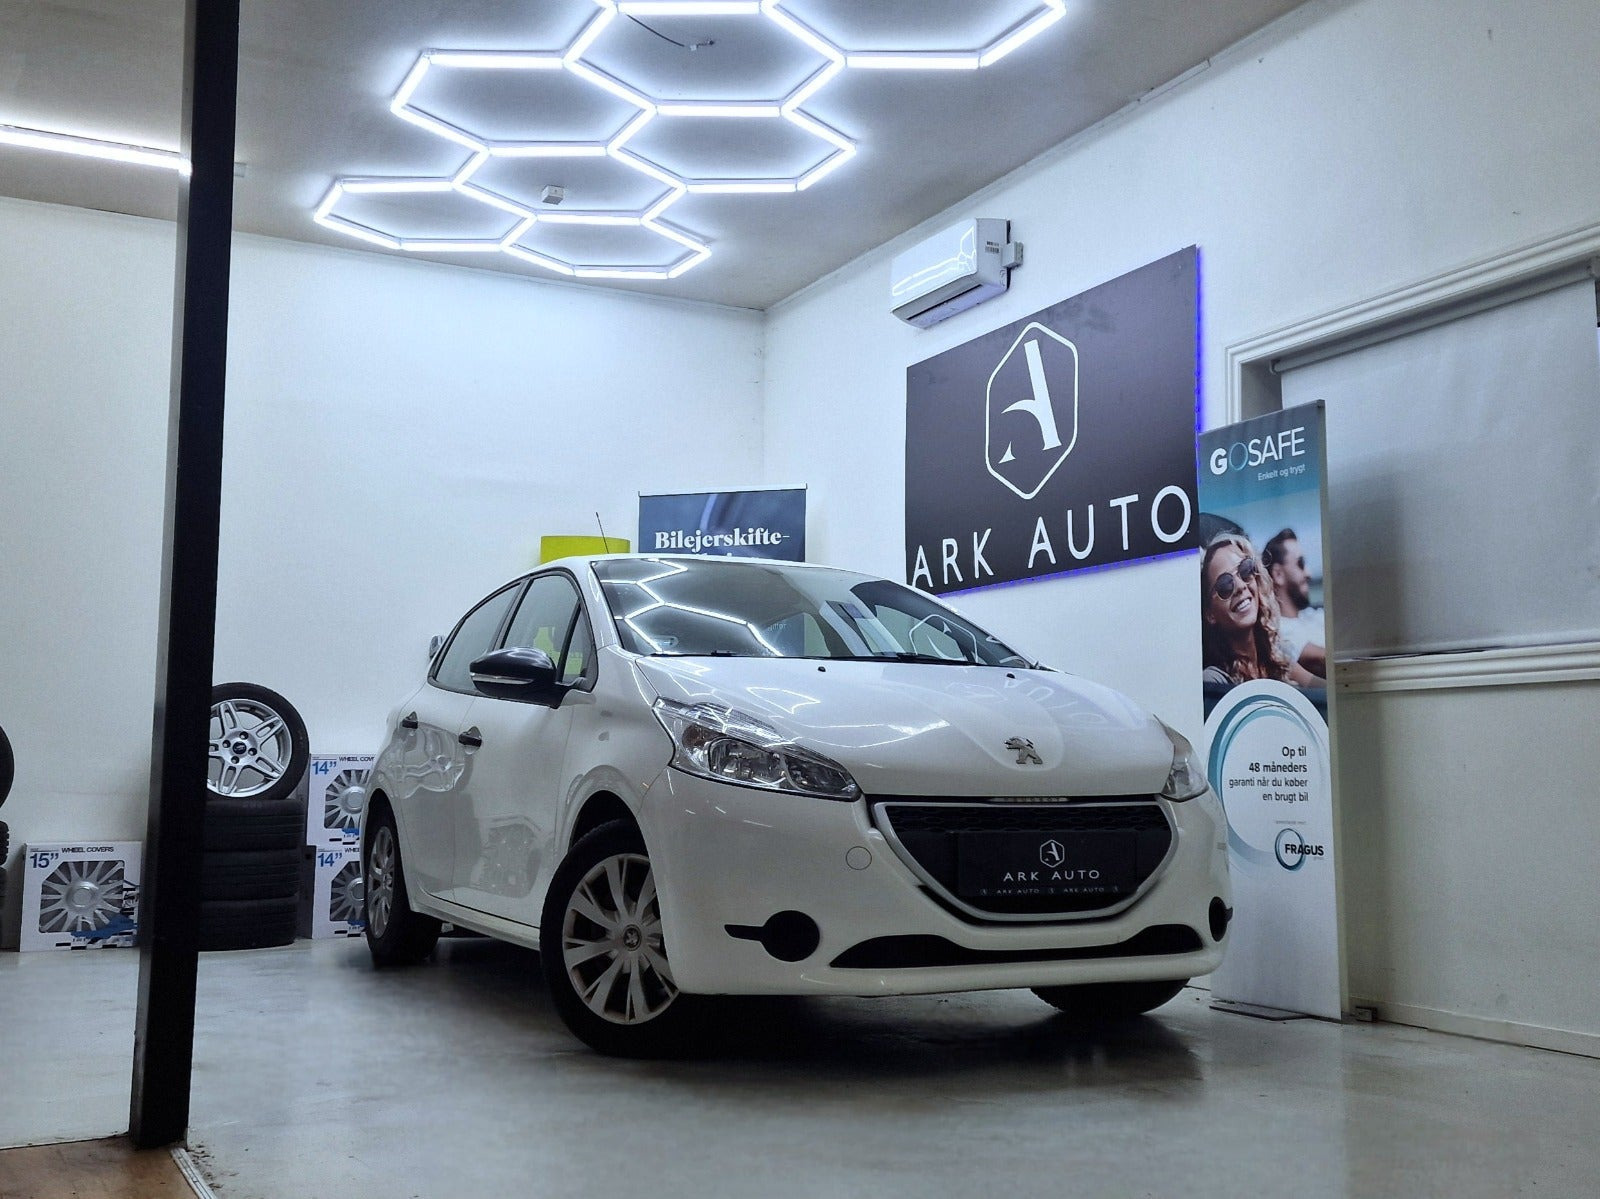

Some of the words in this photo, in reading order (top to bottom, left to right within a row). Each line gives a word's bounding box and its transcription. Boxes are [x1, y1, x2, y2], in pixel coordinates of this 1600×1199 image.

[1210, 426, 1306, 476] GOSAFE
[1257, 470, 1279, 481] Enkelt
[1280, 469, 1289, 477] og
[1290, 464, 1306, 475] trygt
[655, 527, 790, 553] Bilejerskifte-
[912, 528, 994, 588] ARK
[1028, 485, 1192, 569] AUTO
[1282, 746, 1295, 759] Op
[1298, 745, 1307, 757] til
[1249, 762, 1260, 773] 48
[1262, 761, 1308, 773] måneders
[1229, 777, 1254, 788] garanti
[1257, 776, 1269, 787] når
[1272, 777, 1282, 787] du
[1284, 777, 1308, 787] køber
[1262, 793, 1272, 801] en
[1274, 792, 1296, 803] brugt
[1298, 792, 1308, 801] bil
[1284, 843, 1325, 856] FRAGUS
[1003, 871, 1039, 882] ARK
[1051, 869, 1100, 881] AUTO
